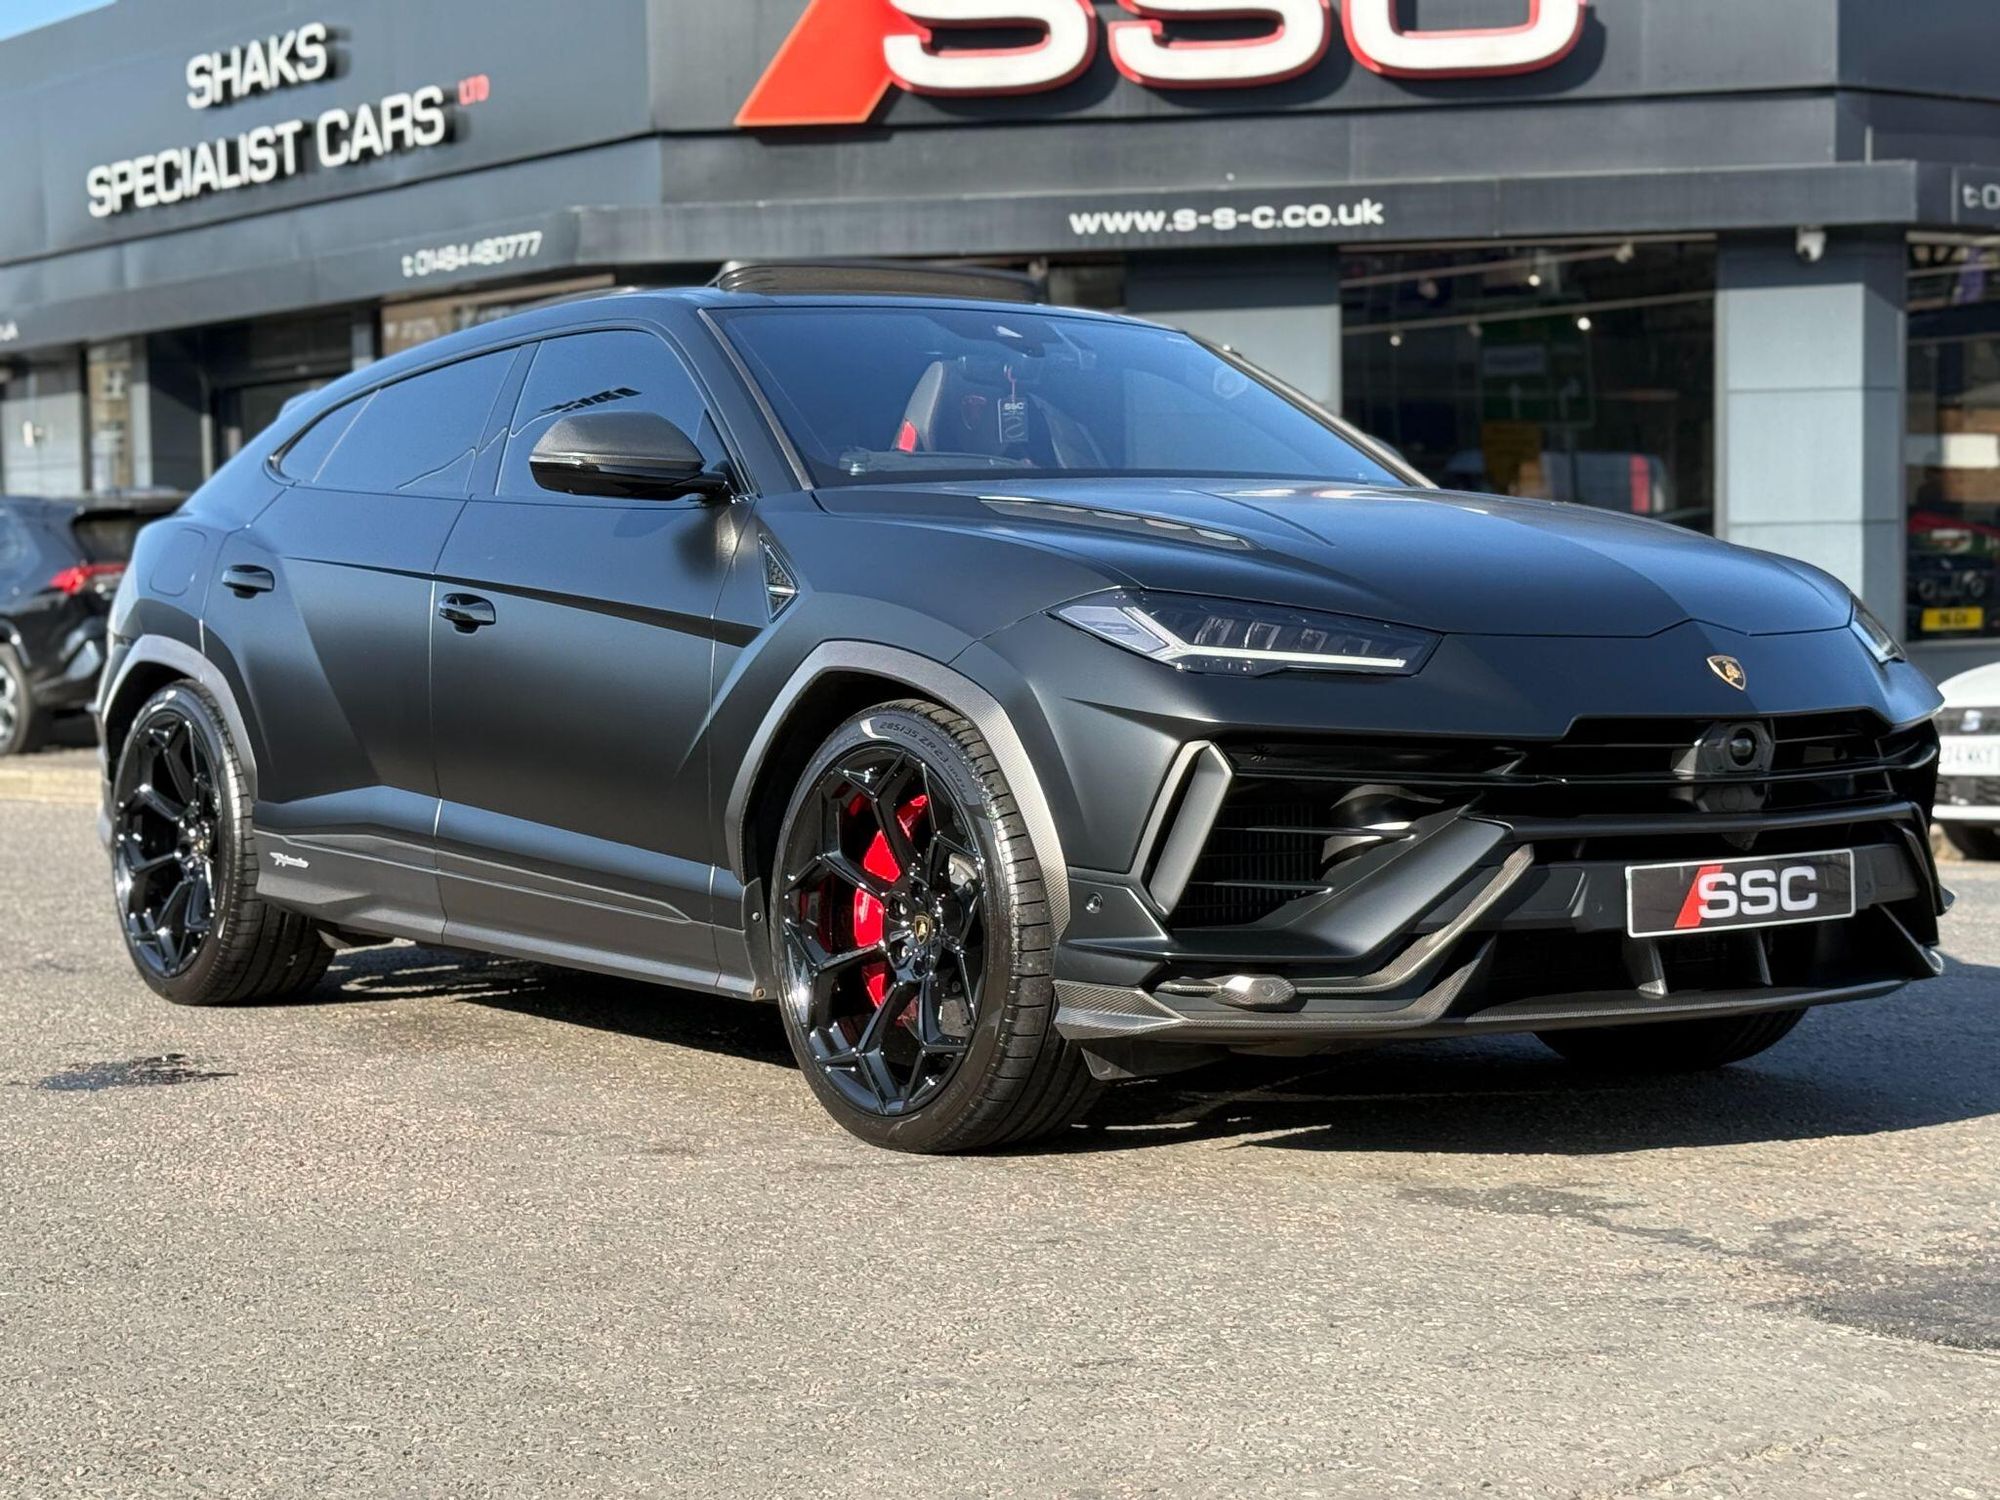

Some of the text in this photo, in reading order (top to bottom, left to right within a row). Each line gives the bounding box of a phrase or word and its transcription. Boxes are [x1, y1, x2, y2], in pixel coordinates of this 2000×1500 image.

[186, 22, 328, 110] SHAKS
[86, 118, 303, 218] SPECIALIST
[316, 85, 446, 168] CARS
[1068, 197, 1385, 235] www.s-s-c.co.uk
[1697, 865, 1818, 919] SSC
